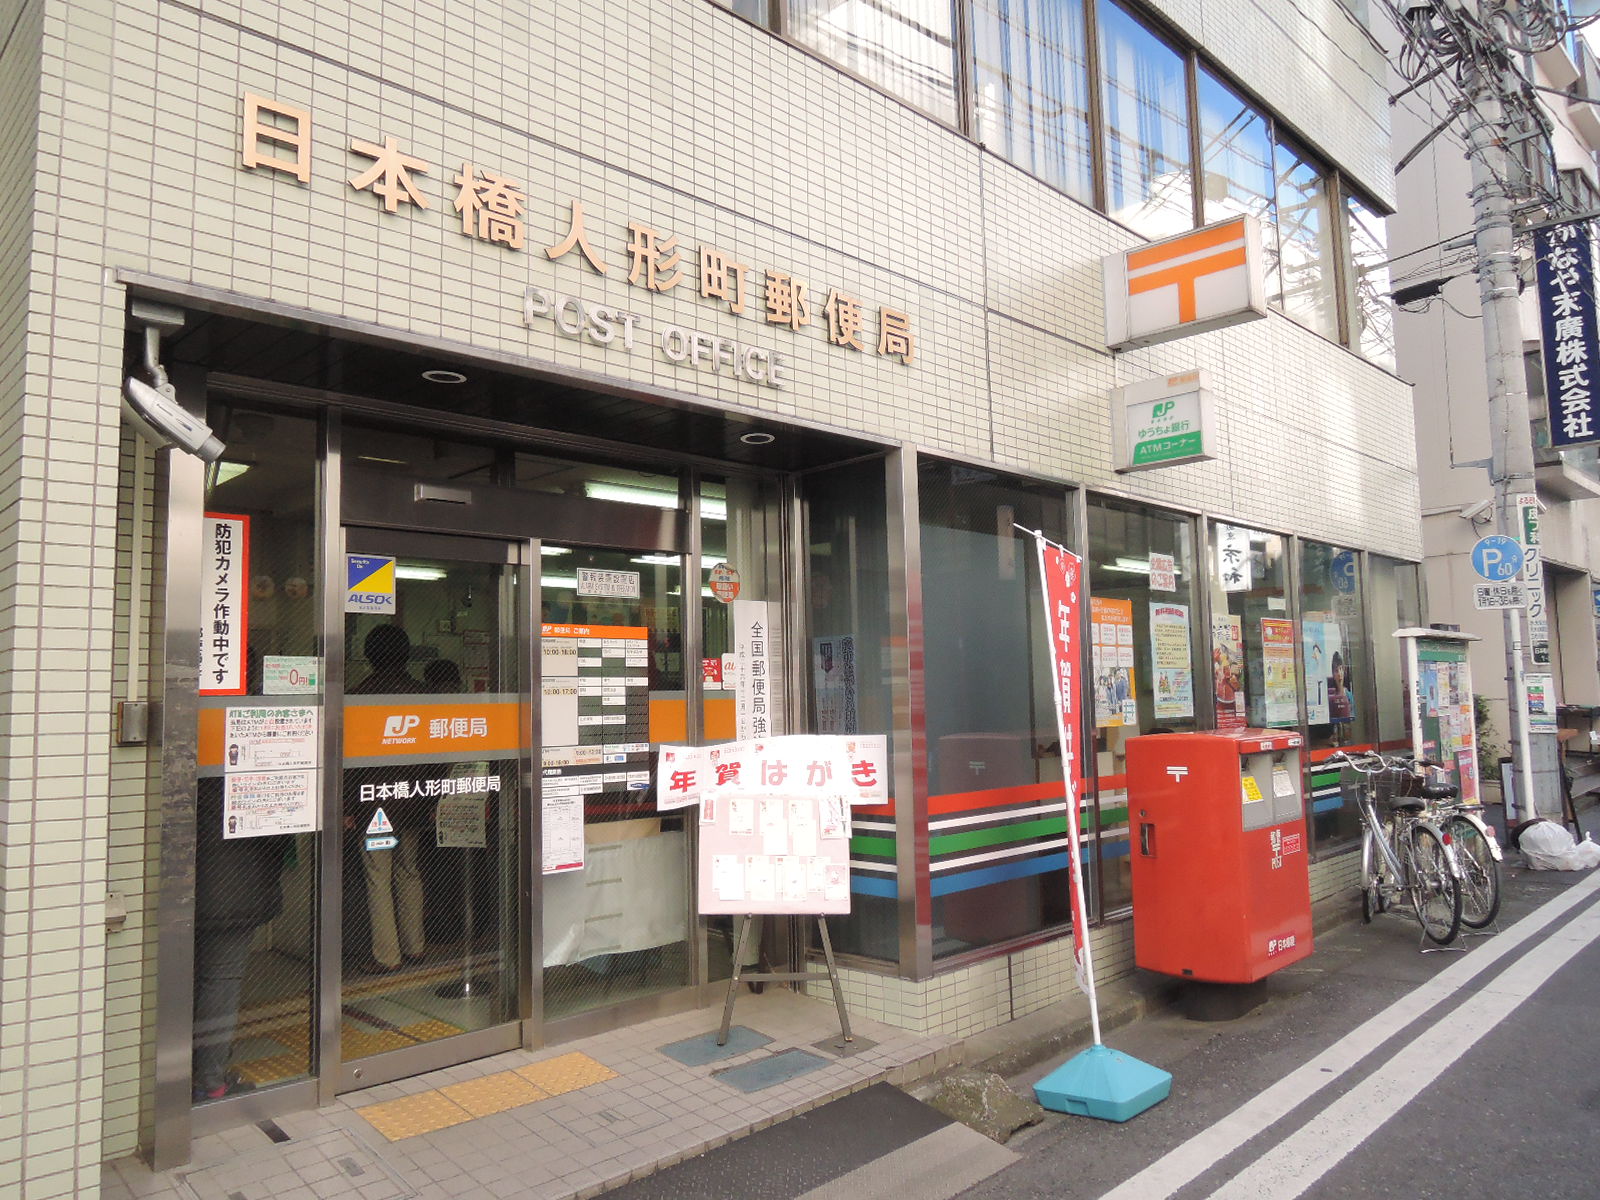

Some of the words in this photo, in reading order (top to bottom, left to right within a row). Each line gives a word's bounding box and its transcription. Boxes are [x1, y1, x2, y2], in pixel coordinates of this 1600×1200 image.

[242, 91, 915, 364] 日本橋人形町郵便局
[524, 286, 641, 349] POST
[661, 325, 786, 388] OFFICE
[1138, 420, 1190, 438] ゆうちょ銀行
[1140, 438, 1196, 454] ATMコーナー
[1482, 548, 1502, 577] P
[1525, 548, 1543, 618] クリニック
[212, 523, 232, 684] 防犯カメラ作動中です
[348, 594, 392, 604] ALSOK
[751, 621, 767, 738] 全国郵便局強
[383, 715, 420, 736] JP
[429, 717, 488, 739] 郵便局
[360, 775, 501, 802] 日本橋人形町郵便局
[669, 759, 877, 793] 年賀はがき
